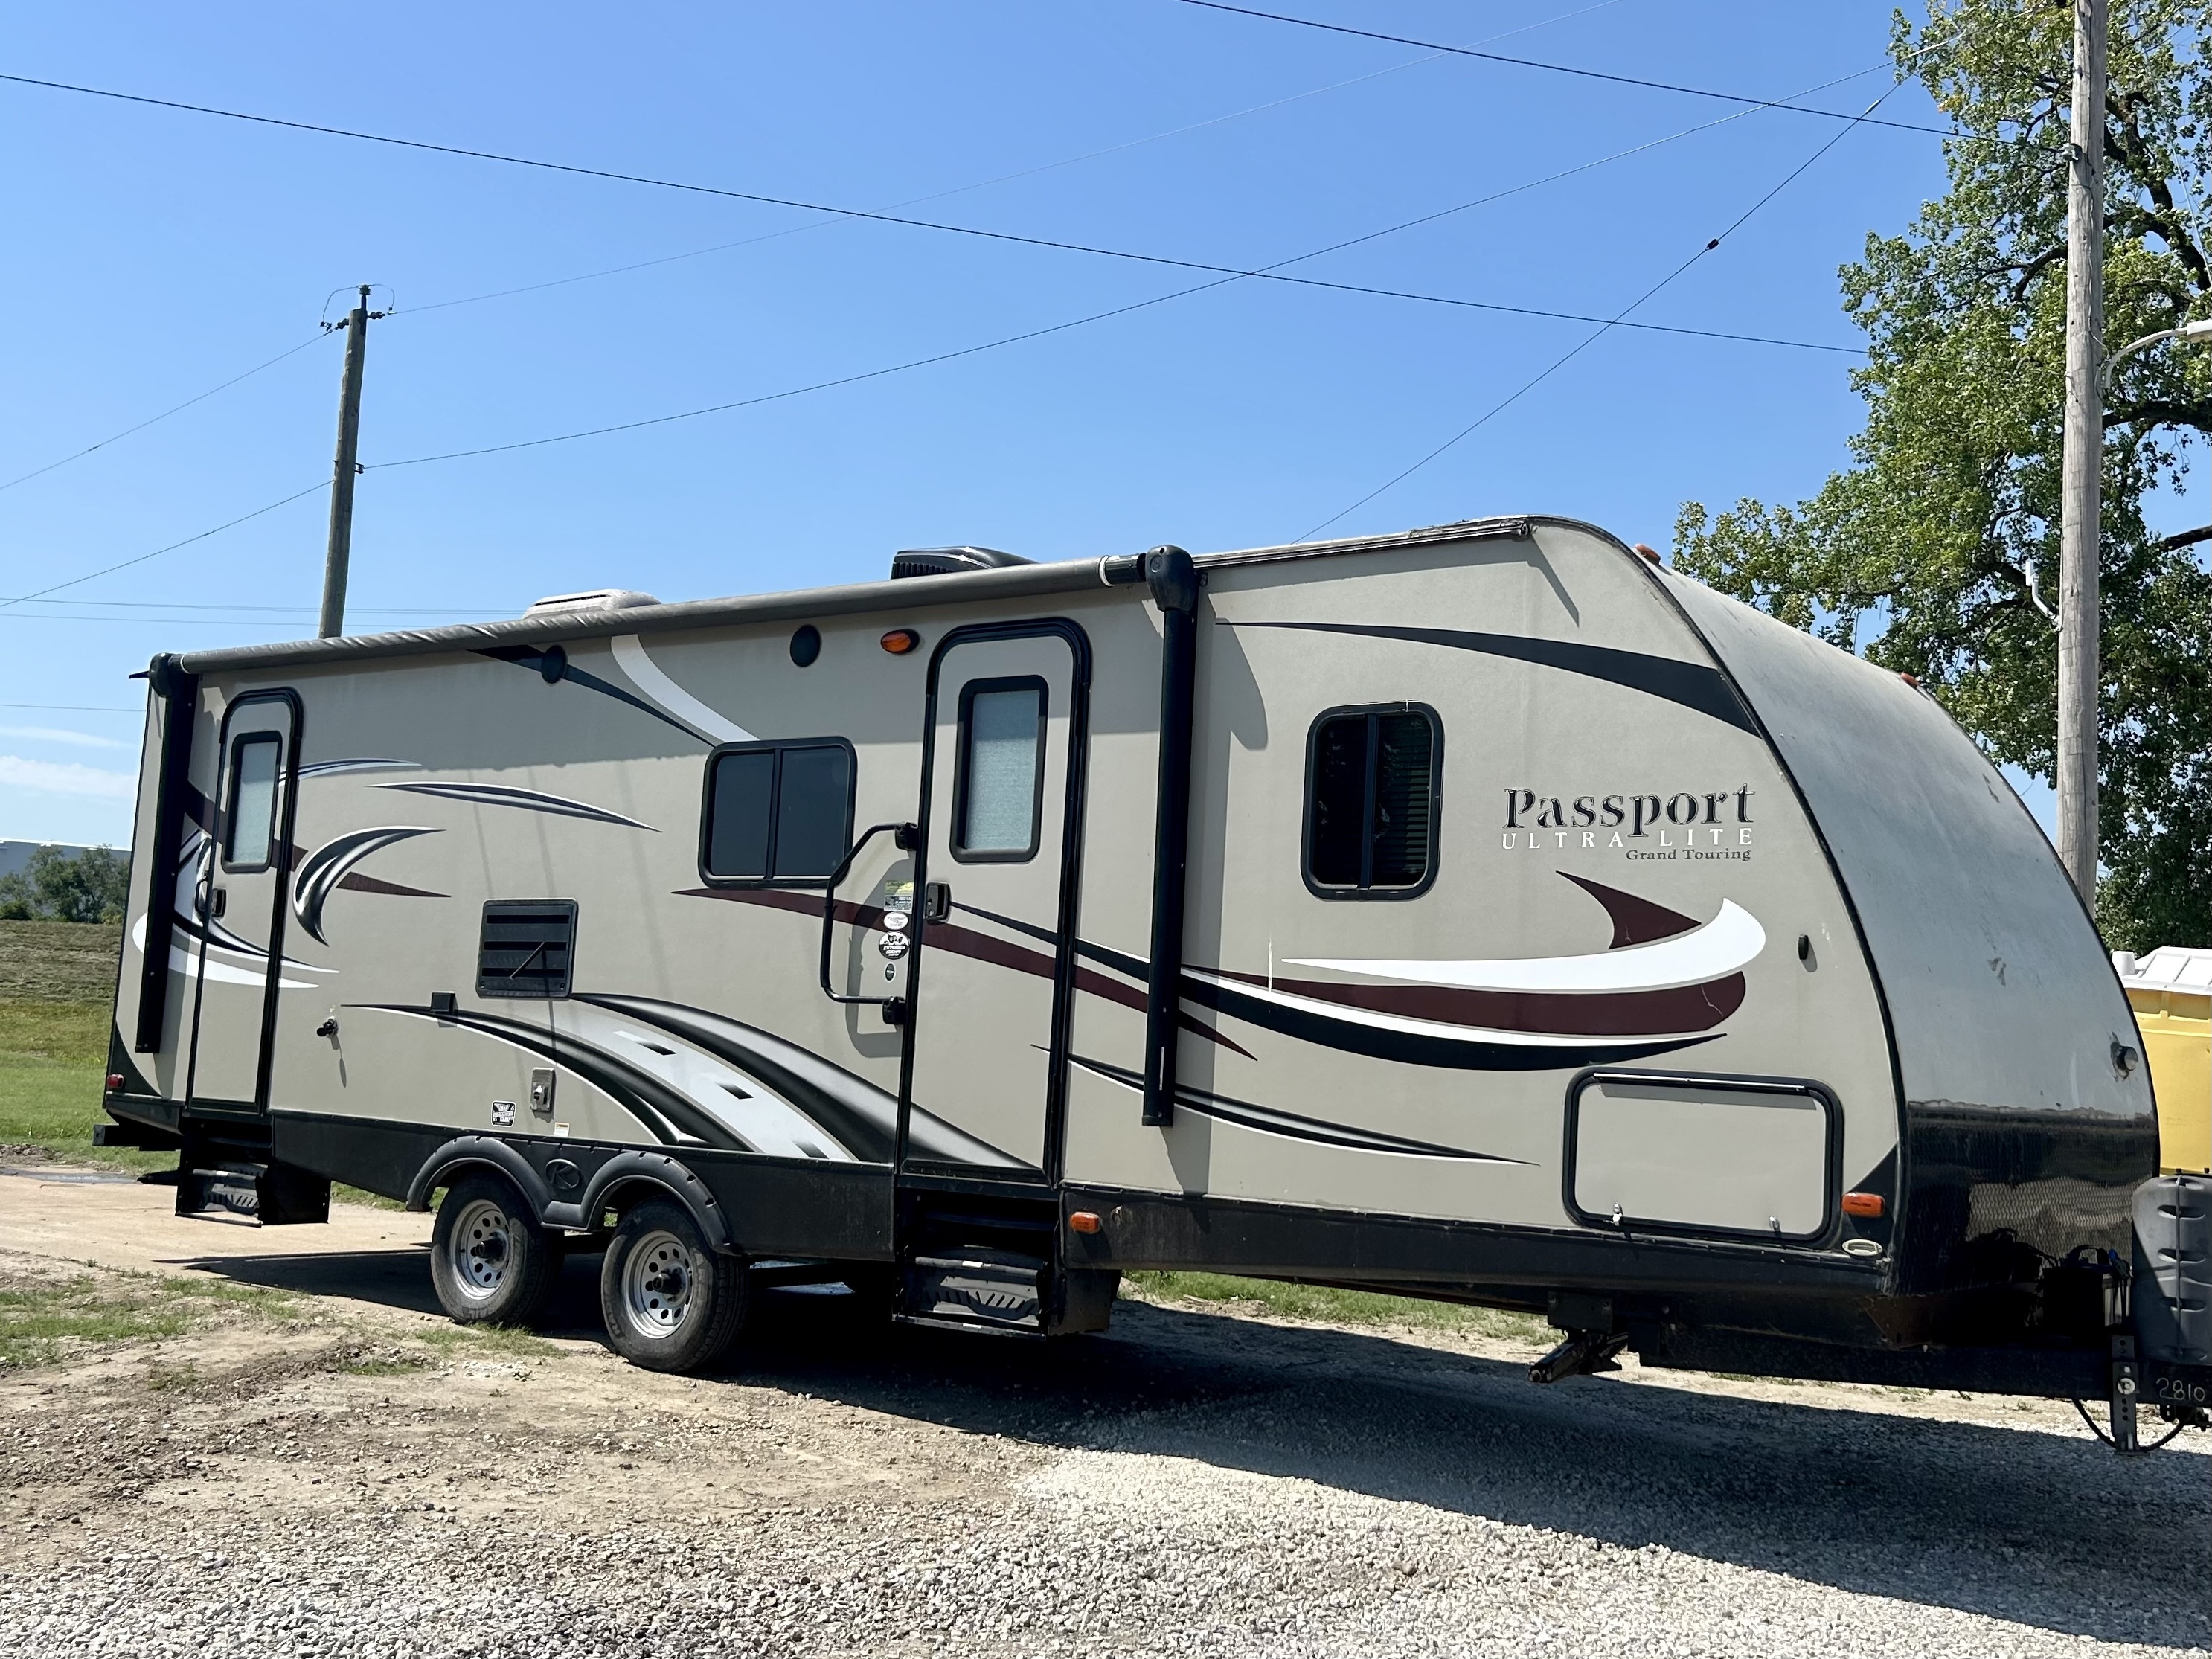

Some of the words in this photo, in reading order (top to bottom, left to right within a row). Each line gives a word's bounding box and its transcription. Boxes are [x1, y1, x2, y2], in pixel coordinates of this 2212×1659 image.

[1501, 783, 1756, 838] Passport
[1501, 831, 1624, 850] ULTRA
[1659, 827, 1753, 847] LITE
[1626, 849, 1677, 861] Grand
[1683, 848, 1751, 861] Touring
[2156, 1378, 2206, 1402] 2810
